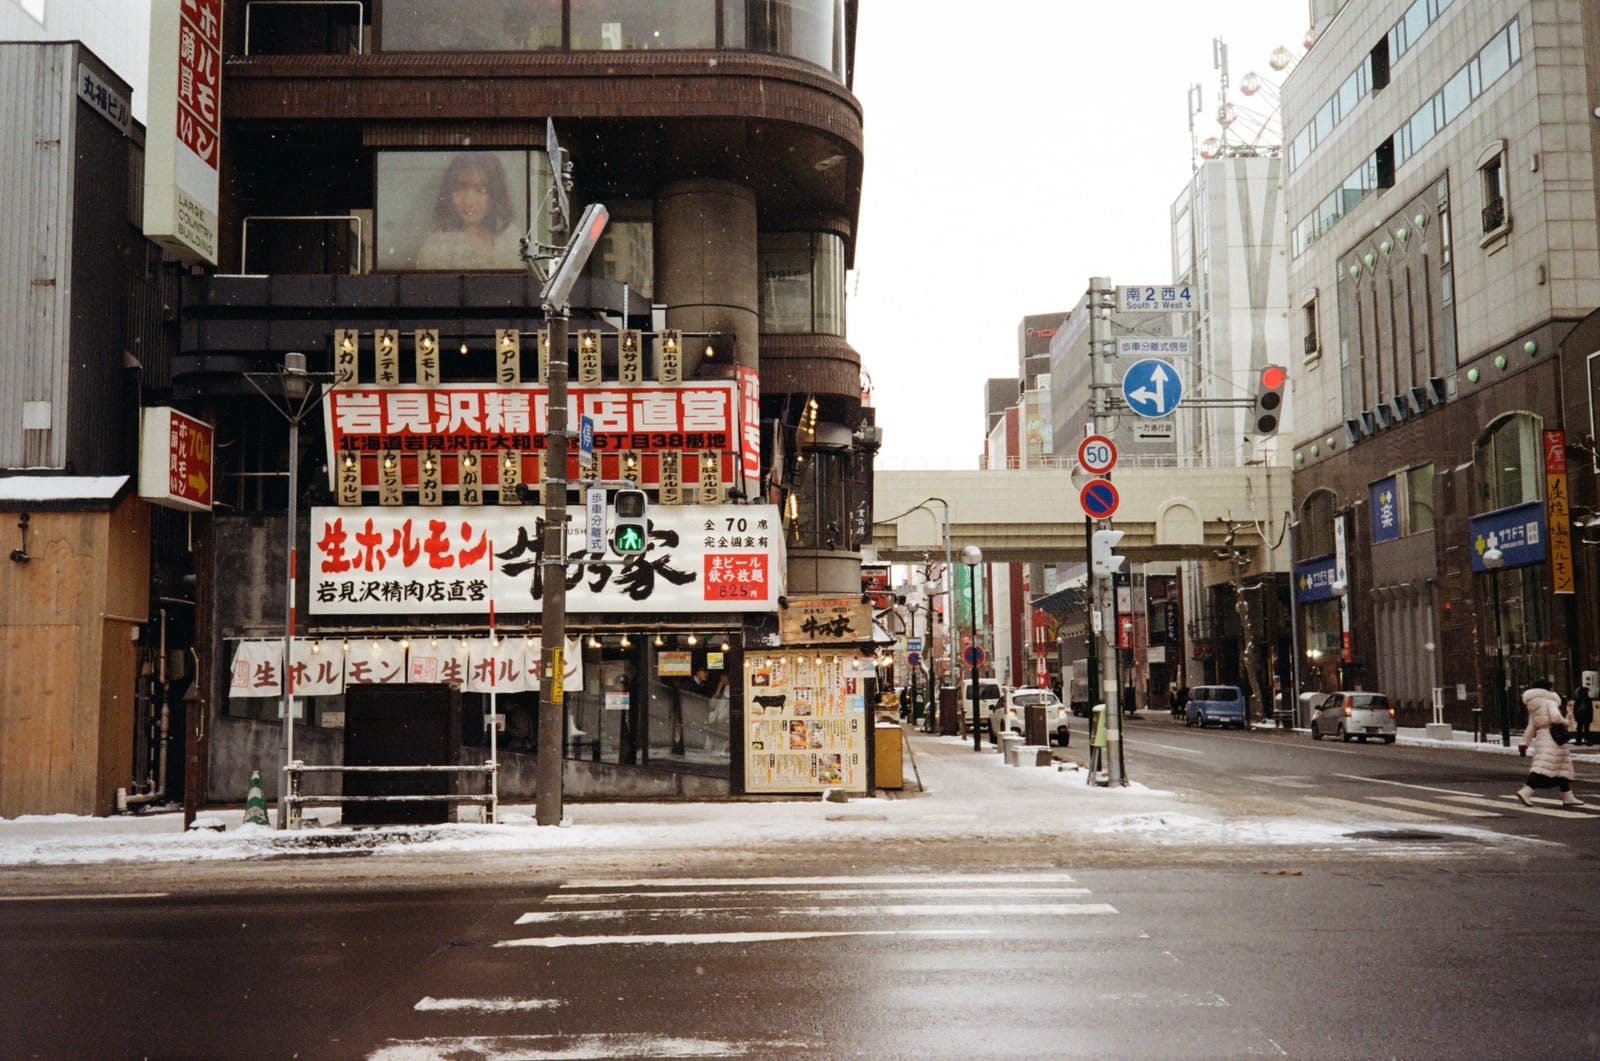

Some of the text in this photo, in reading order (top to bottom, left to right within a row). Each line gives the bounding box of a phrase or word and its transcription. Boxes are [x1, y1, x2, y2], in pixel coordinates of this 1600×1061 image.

[197, 3, 217, 161] ホルモン
[179, 194, 205, 221] LARGE
[178, 208, 213, 241] COUNTRY
[179, 421, 187, 495] ホルモン
[1087, 447, 1108, 463] 50
[592, 493, 602, 549] 歩車分離式
[704, 519, 715, 531] 全
[725, 518, 747, 532] 70
[317, 517, 488, 573] 生ホルモン
[708, 569, 763, 583] 飲み放題
[712, 556, 761, 569] 生ビール
[317, 580, 488, 603] 岩見沢精肉店直営
